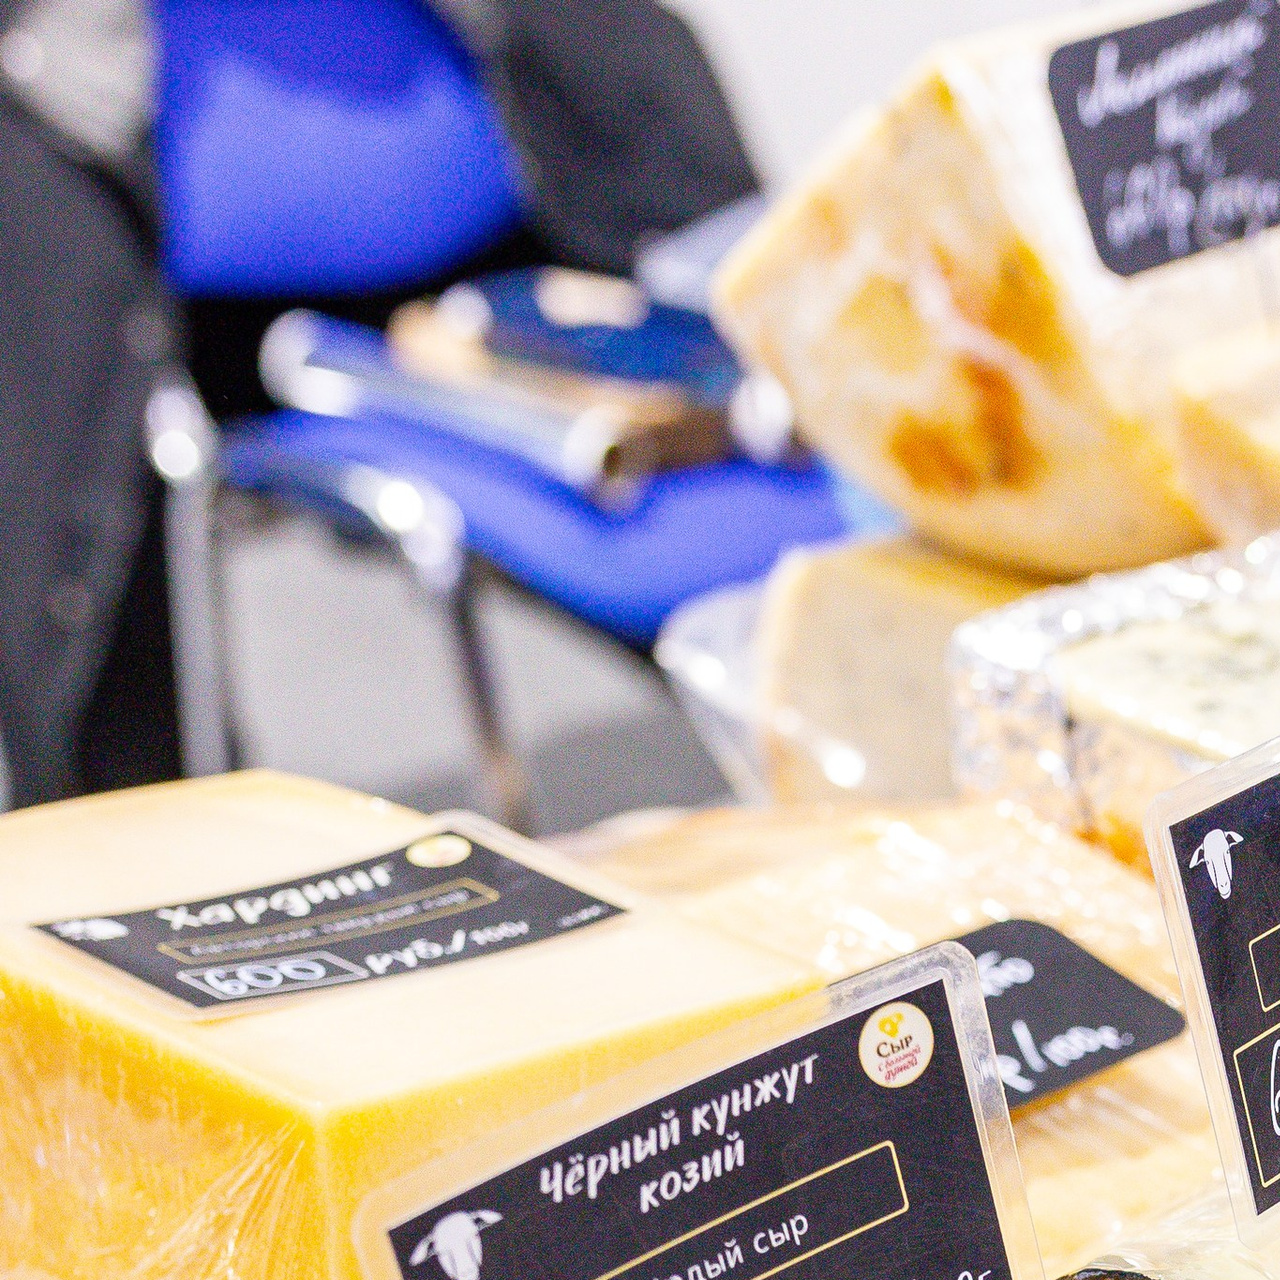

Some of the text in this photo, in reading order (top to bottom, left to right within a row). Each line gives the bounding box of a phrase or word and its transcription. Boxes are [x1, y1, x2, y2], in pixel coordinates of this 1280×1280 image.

[204, 959, 327, 997] 600
[538, 1054, 821, 1204] Чёрный кунжут
[638, 1132, 747, 1214] козий
[752, 1211, 811, 1257] сыр
